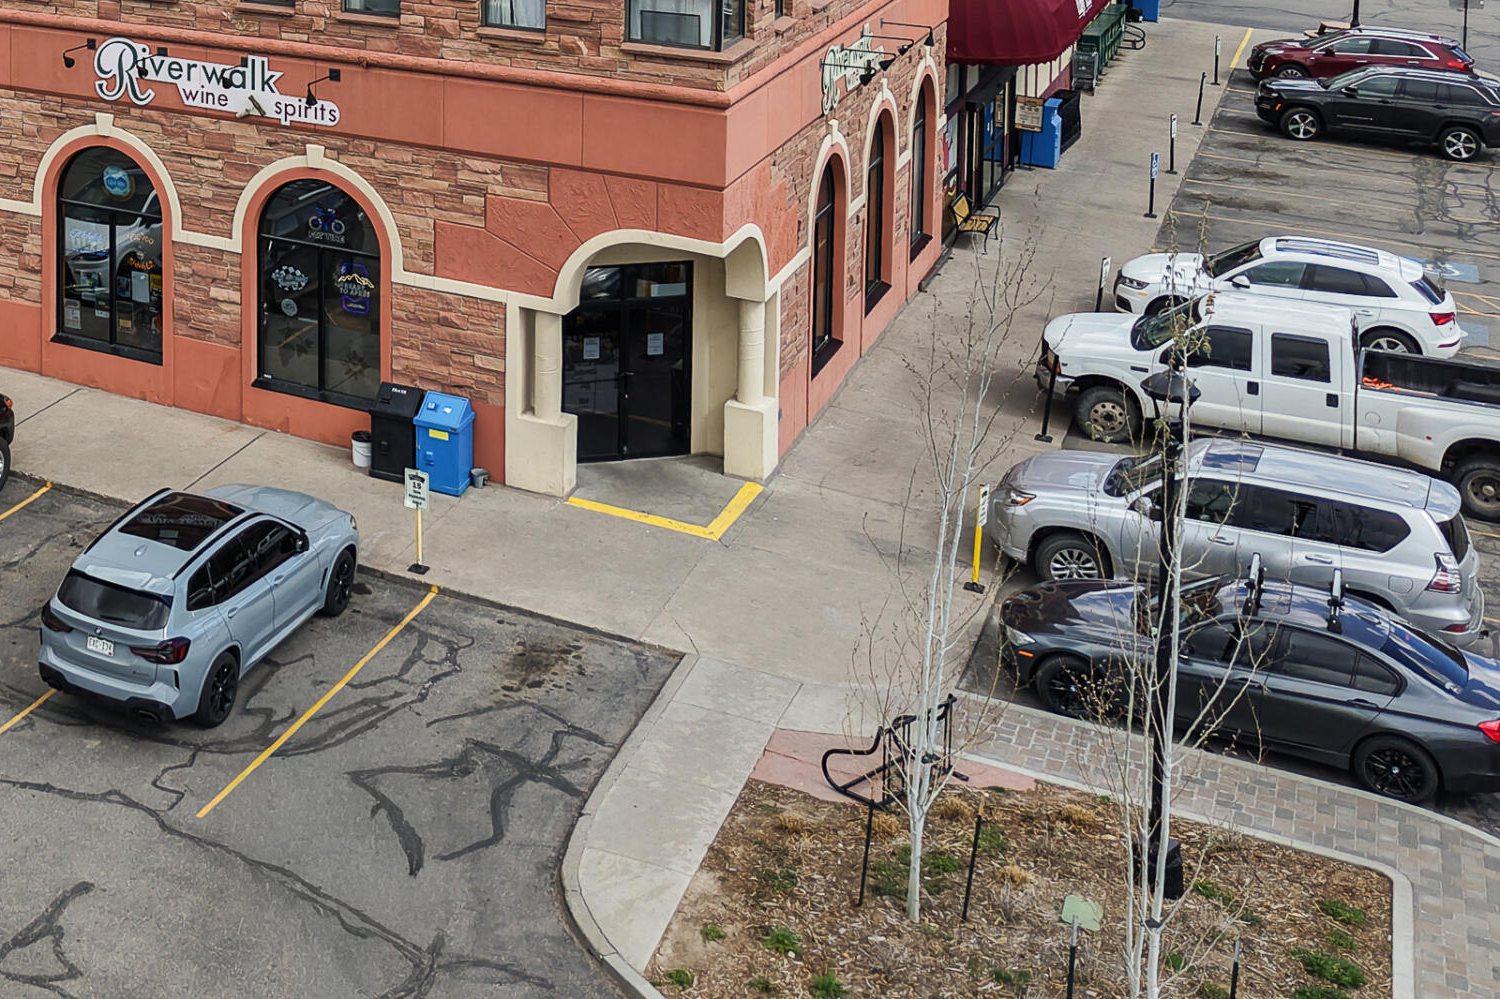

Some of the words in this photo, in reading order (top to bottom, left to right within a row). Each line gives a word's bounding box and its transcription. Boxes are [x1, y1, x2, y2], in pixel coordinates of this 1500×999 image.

[97, 41, 276, 101] Riverwalk
[182, 85, 229, 106] wine
[274, 98, 337, 123] spirits
[412, 481, 422, 490] 15
